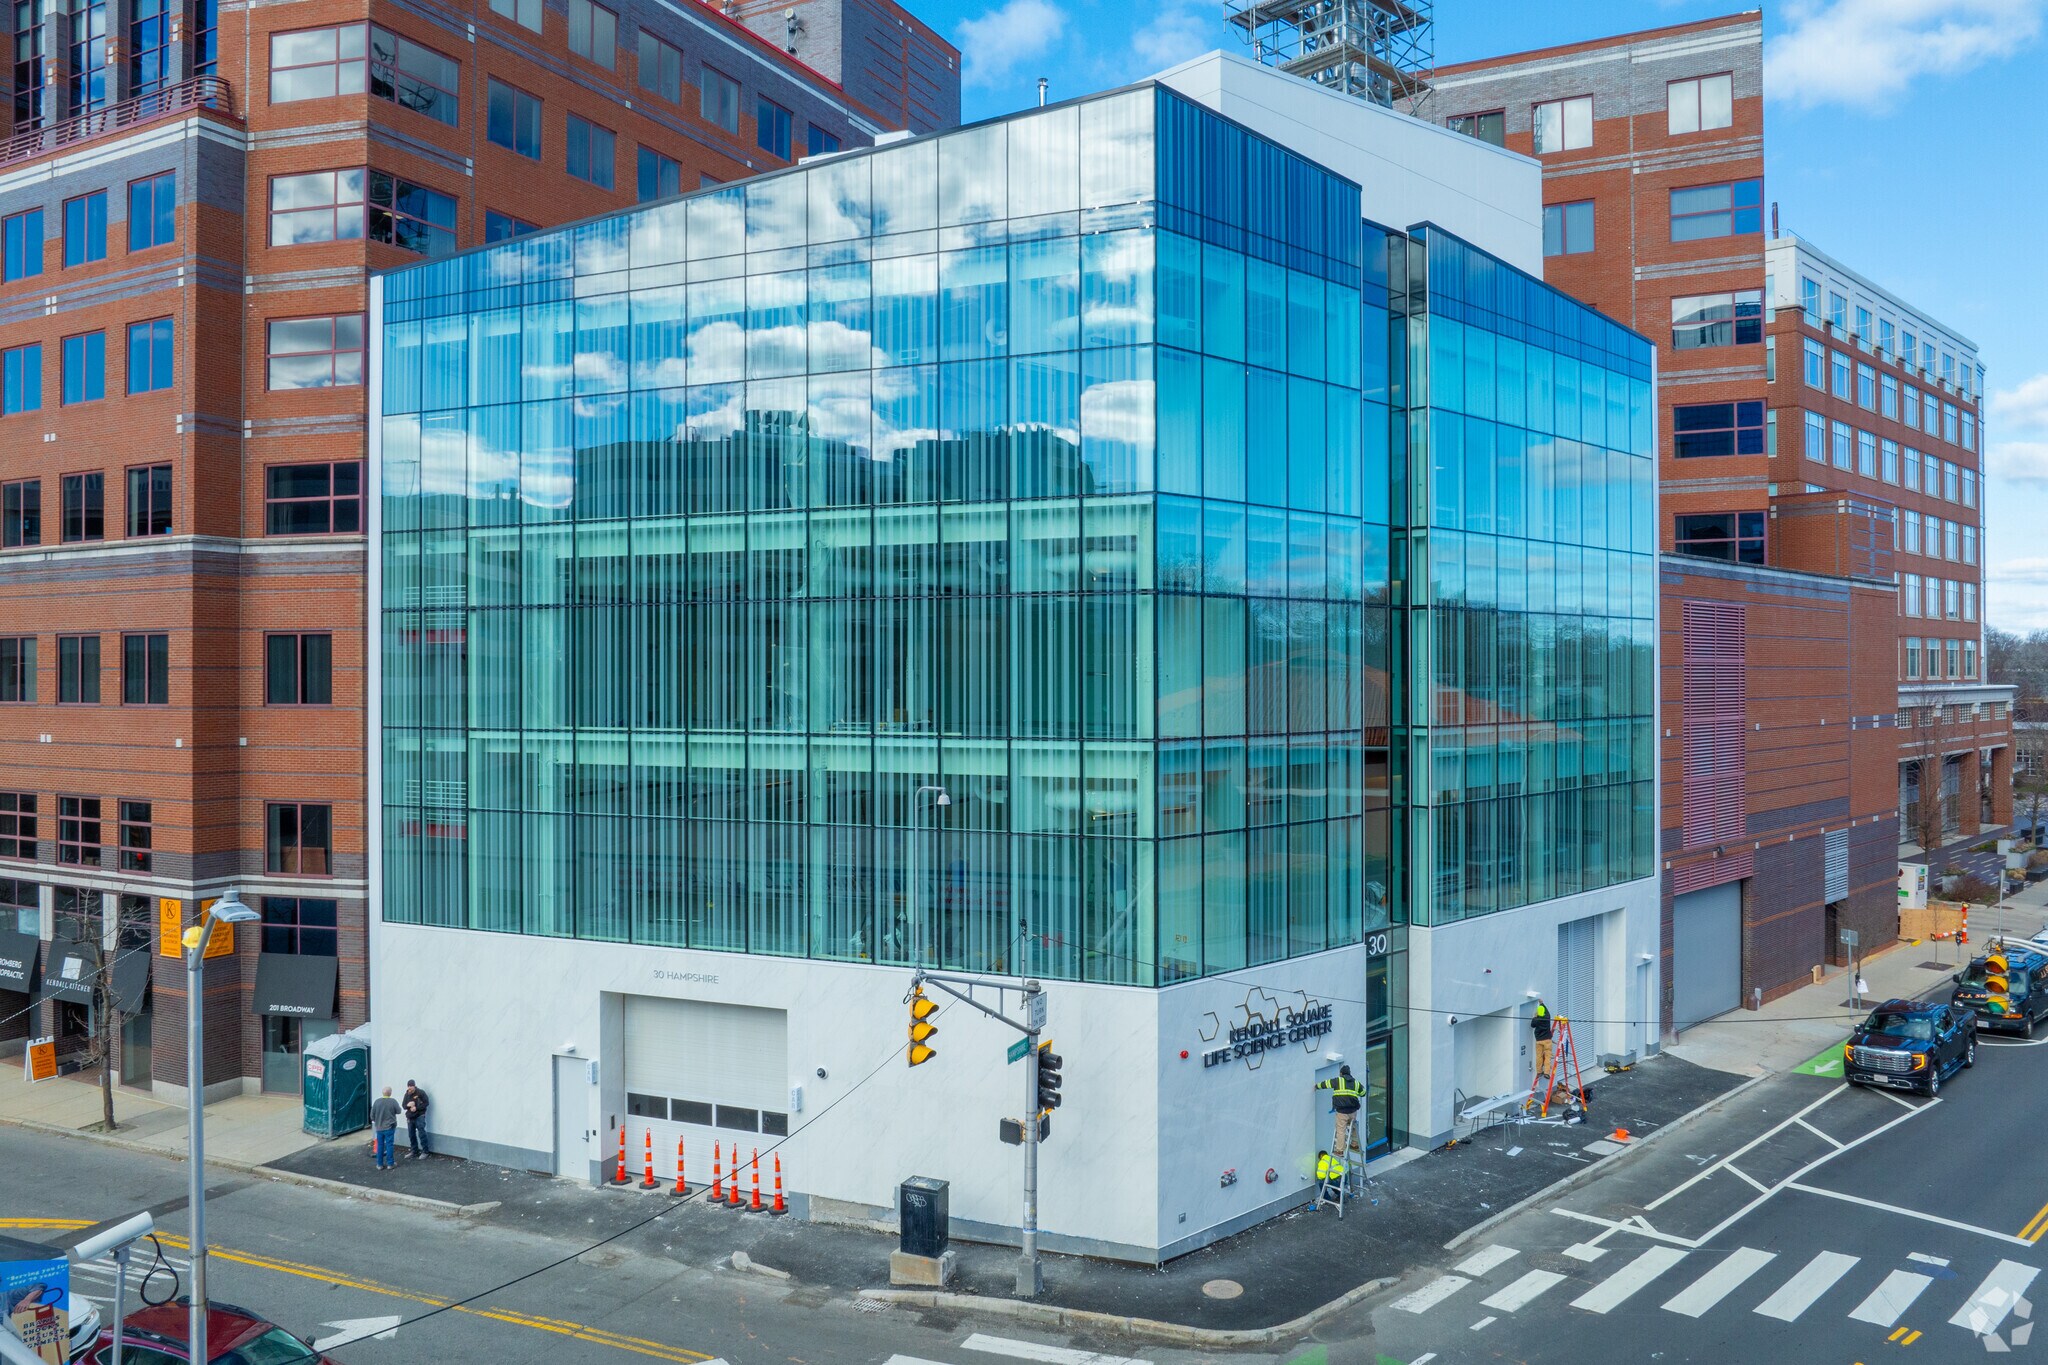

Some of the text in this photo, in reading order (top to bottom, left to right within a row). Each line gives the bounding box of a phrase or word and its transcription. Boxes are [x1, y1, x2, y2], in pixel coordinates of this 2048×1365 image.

[1369, 934, 1387, 955] 30
[653, 970, 719, 984] 30 HAMPSHIRE
[46, 979, 91, 993] KENDALL KITCHEN
[280, 1005, 315, 1013] BROADWAY
[1230, 1004, 1332, 1045] KENDALL SQUARE
[1204, 1020, 1332, 1068] LIFE SCIENCE CENTER
[41, 1265, 56, 1274] you
[23, 1315, 61, 1329] BRAKES
[23, 1323, 60, 1337] SHOCKS
